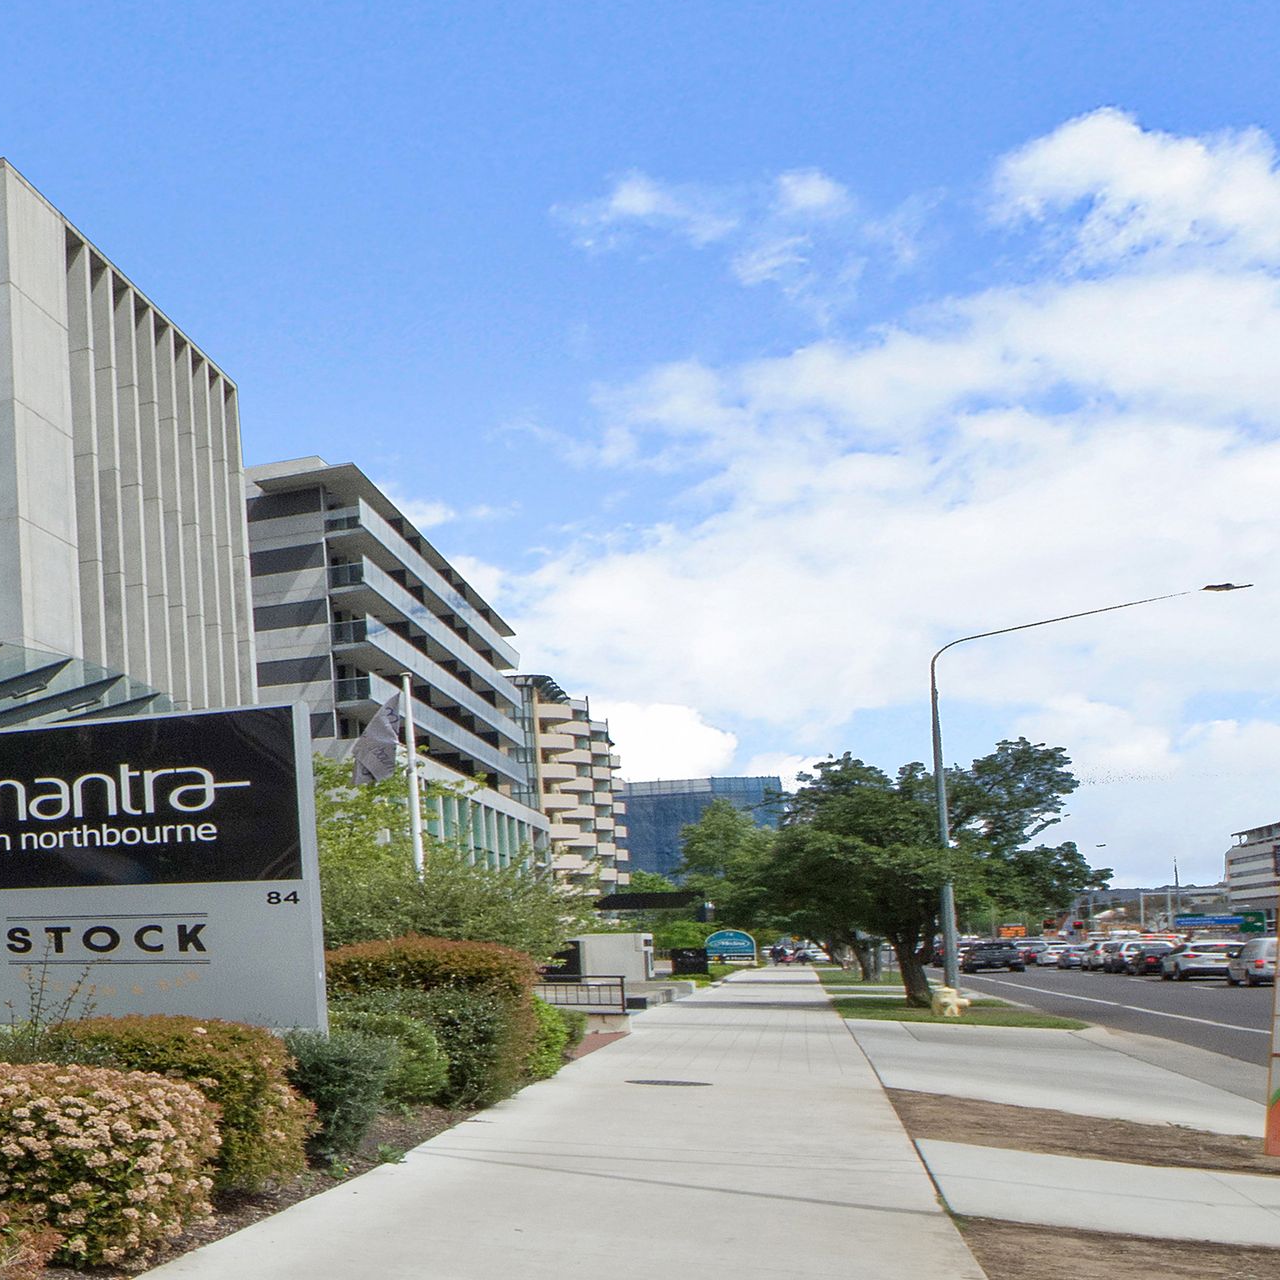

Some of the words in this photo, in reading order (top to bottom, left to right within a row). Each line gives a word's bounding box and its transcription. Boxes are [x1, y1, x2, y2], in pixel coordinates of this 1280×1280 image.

[21, 822, 218, 851] northbourne
[266, 890, 300, 905] 84
[6, 923, 209, 953] STOCK
